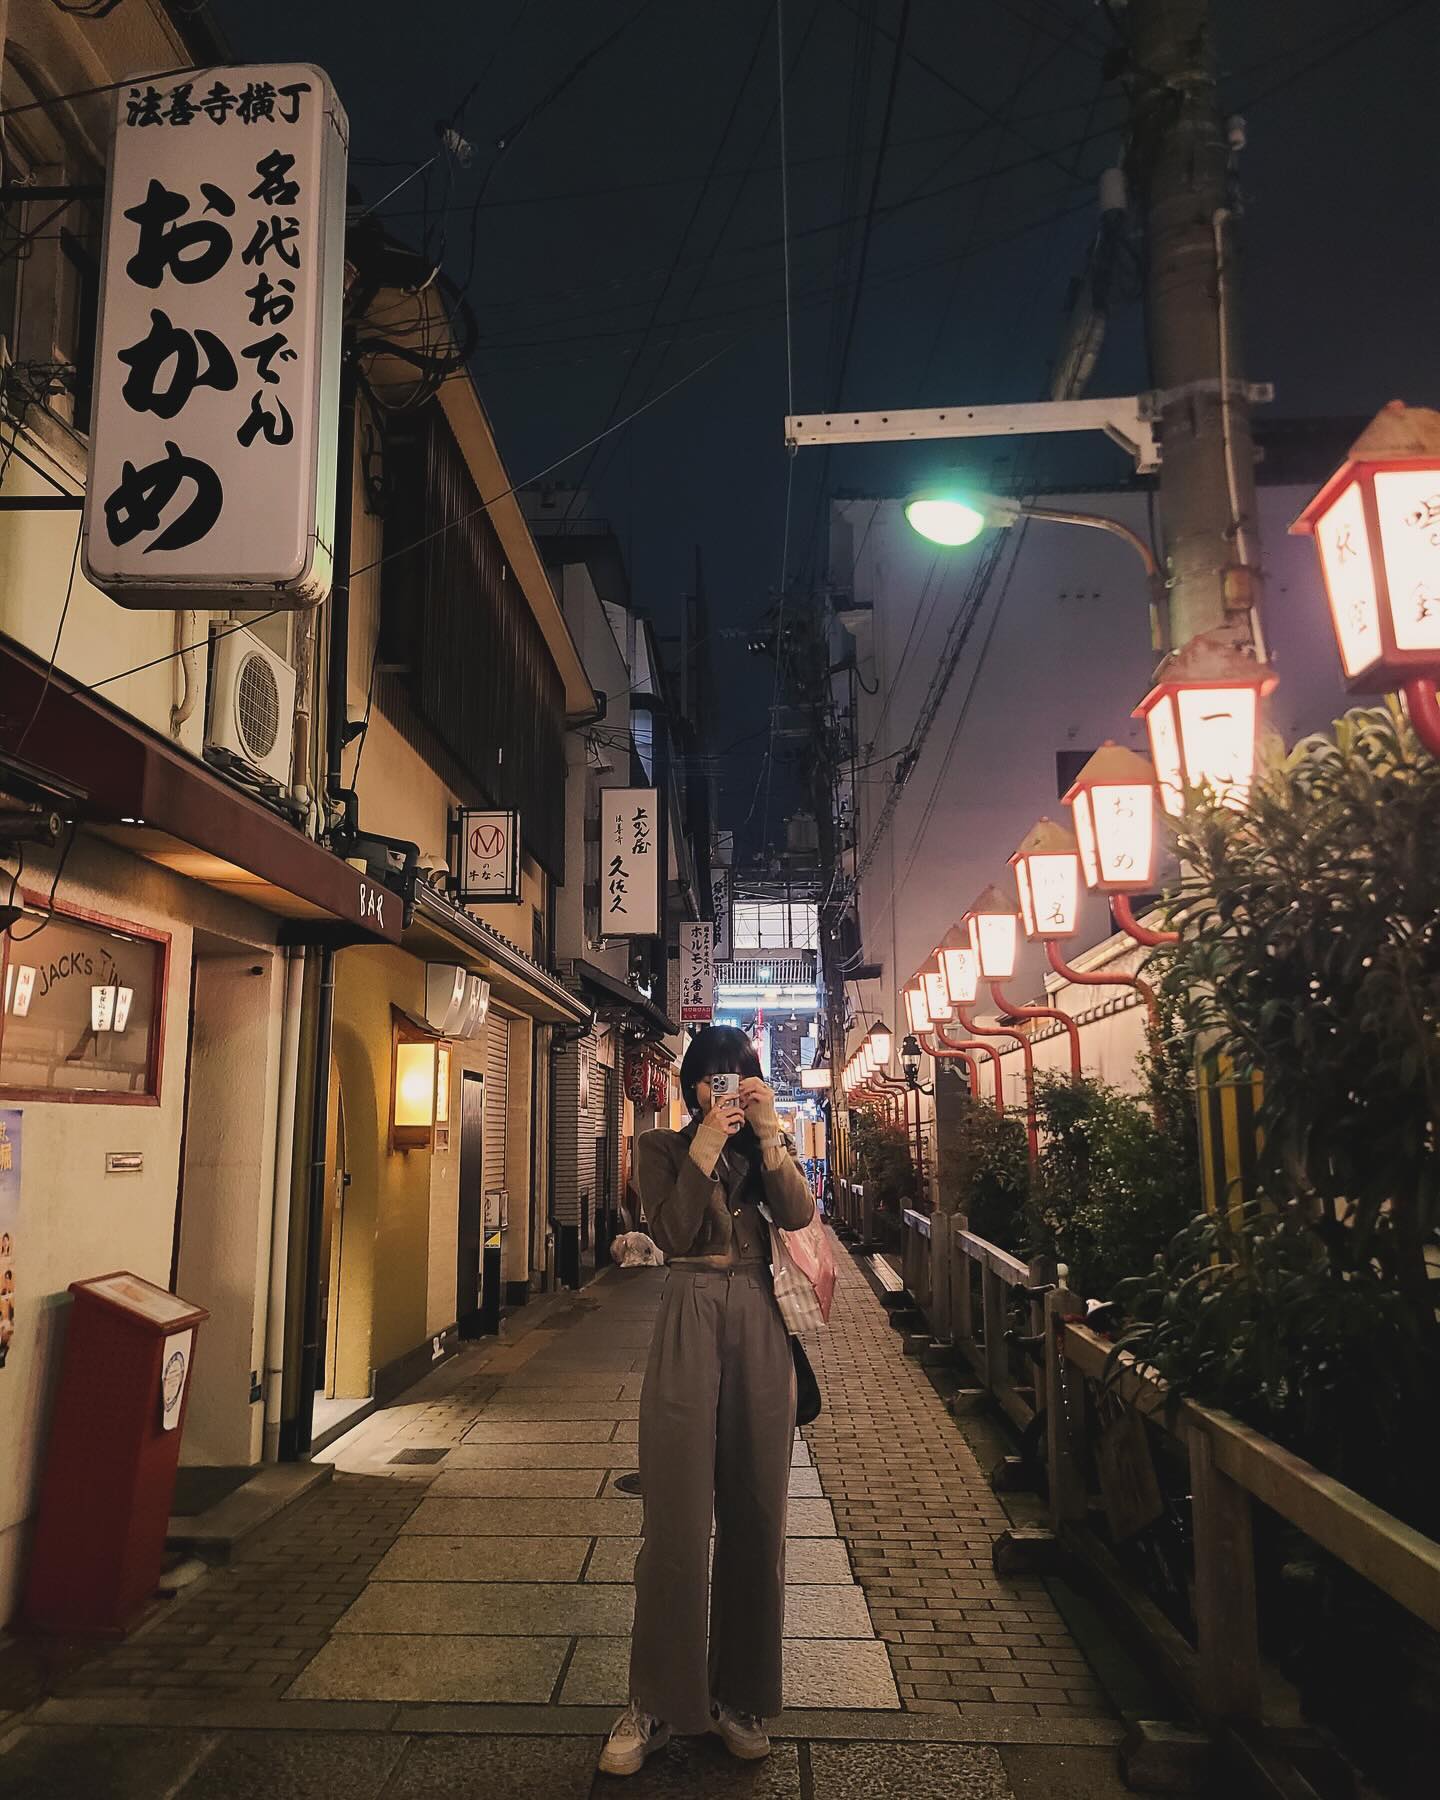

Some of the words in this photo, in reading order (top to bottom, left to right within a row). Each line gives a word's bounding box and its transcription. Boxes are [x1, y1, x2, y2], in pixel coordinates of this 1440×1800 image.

[126, 82, 311, 127] 法善寺横丁
[236, 149, 302, 448] 名代おでん
[103, 178, 239, 554] おかめ
[472, 826, 503, 857] M
[468, 869, 505, 881] 牛なべ
[360, 883, 384, 929] BAR
[690, 925, 704, 1005] ホルモン番長
